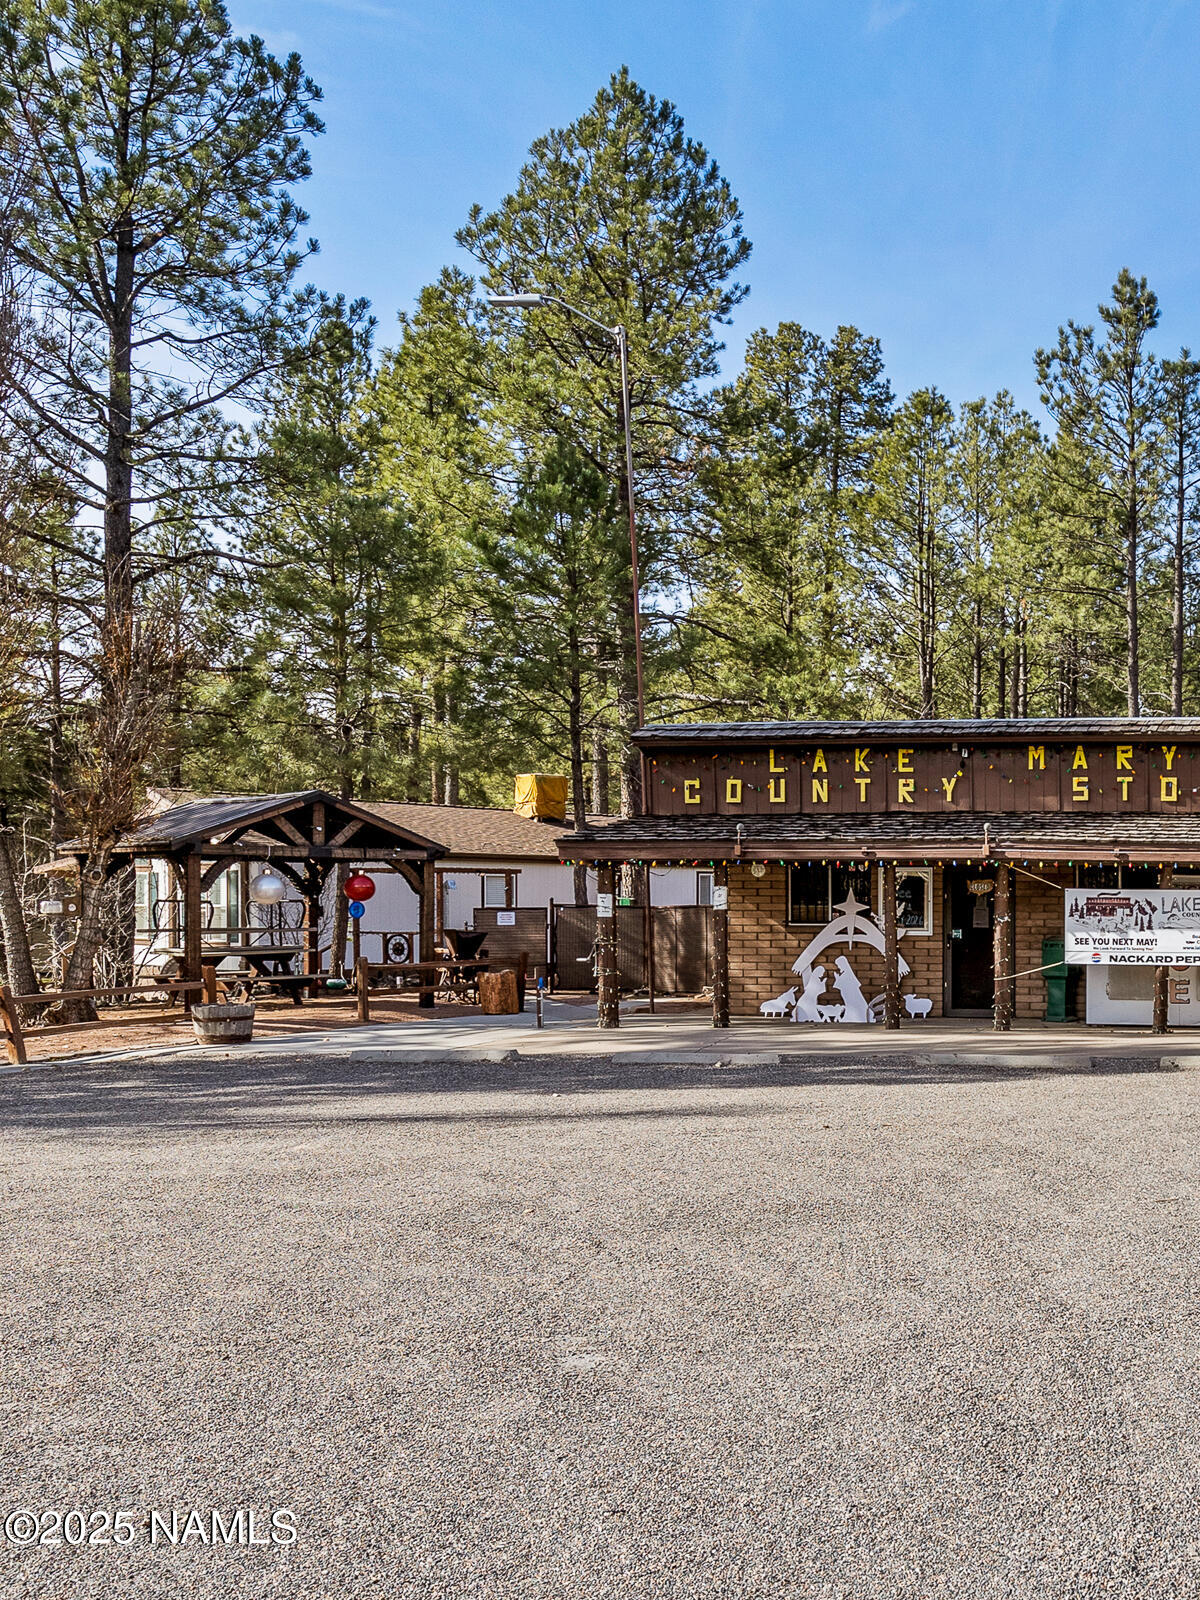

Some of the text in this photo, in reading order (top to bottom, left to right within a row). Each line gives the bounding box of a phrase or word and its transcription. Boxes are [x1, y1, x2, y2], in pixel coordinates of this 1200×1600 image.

[769, 745, 1177, 773] LAKE MARY
[684, 777, 957, 804] COUNTRY
[1074, 937, 1158, 946] SEE YOU NEXT MAY!
[1109, 955, 1173, 963] NACKARD
